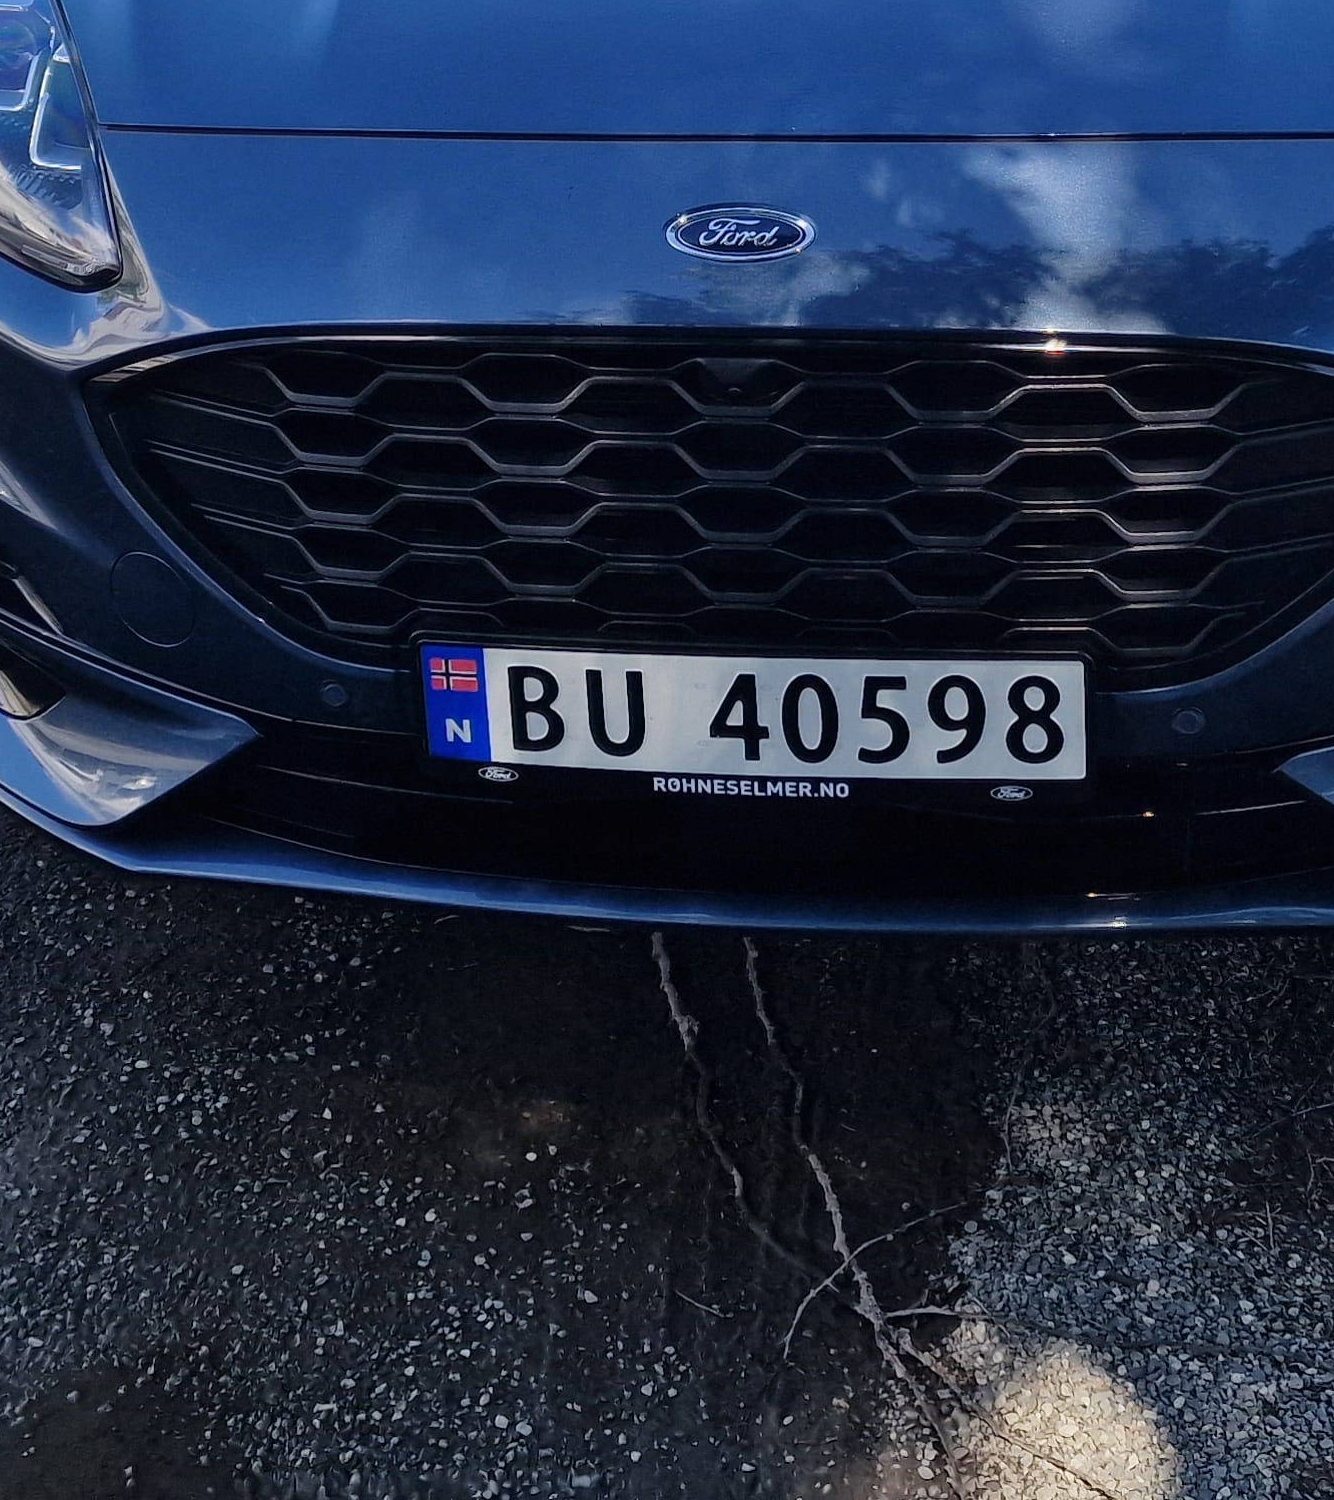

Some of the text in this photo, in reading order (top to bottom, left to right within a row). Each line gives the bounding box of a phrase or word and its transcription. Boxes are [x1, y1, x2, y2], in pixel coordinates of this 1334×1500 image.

[698, 217, 781, 248] Ford
[507, 665, 1065, 765] BU 40598
[445, 718, 473, 744] N
